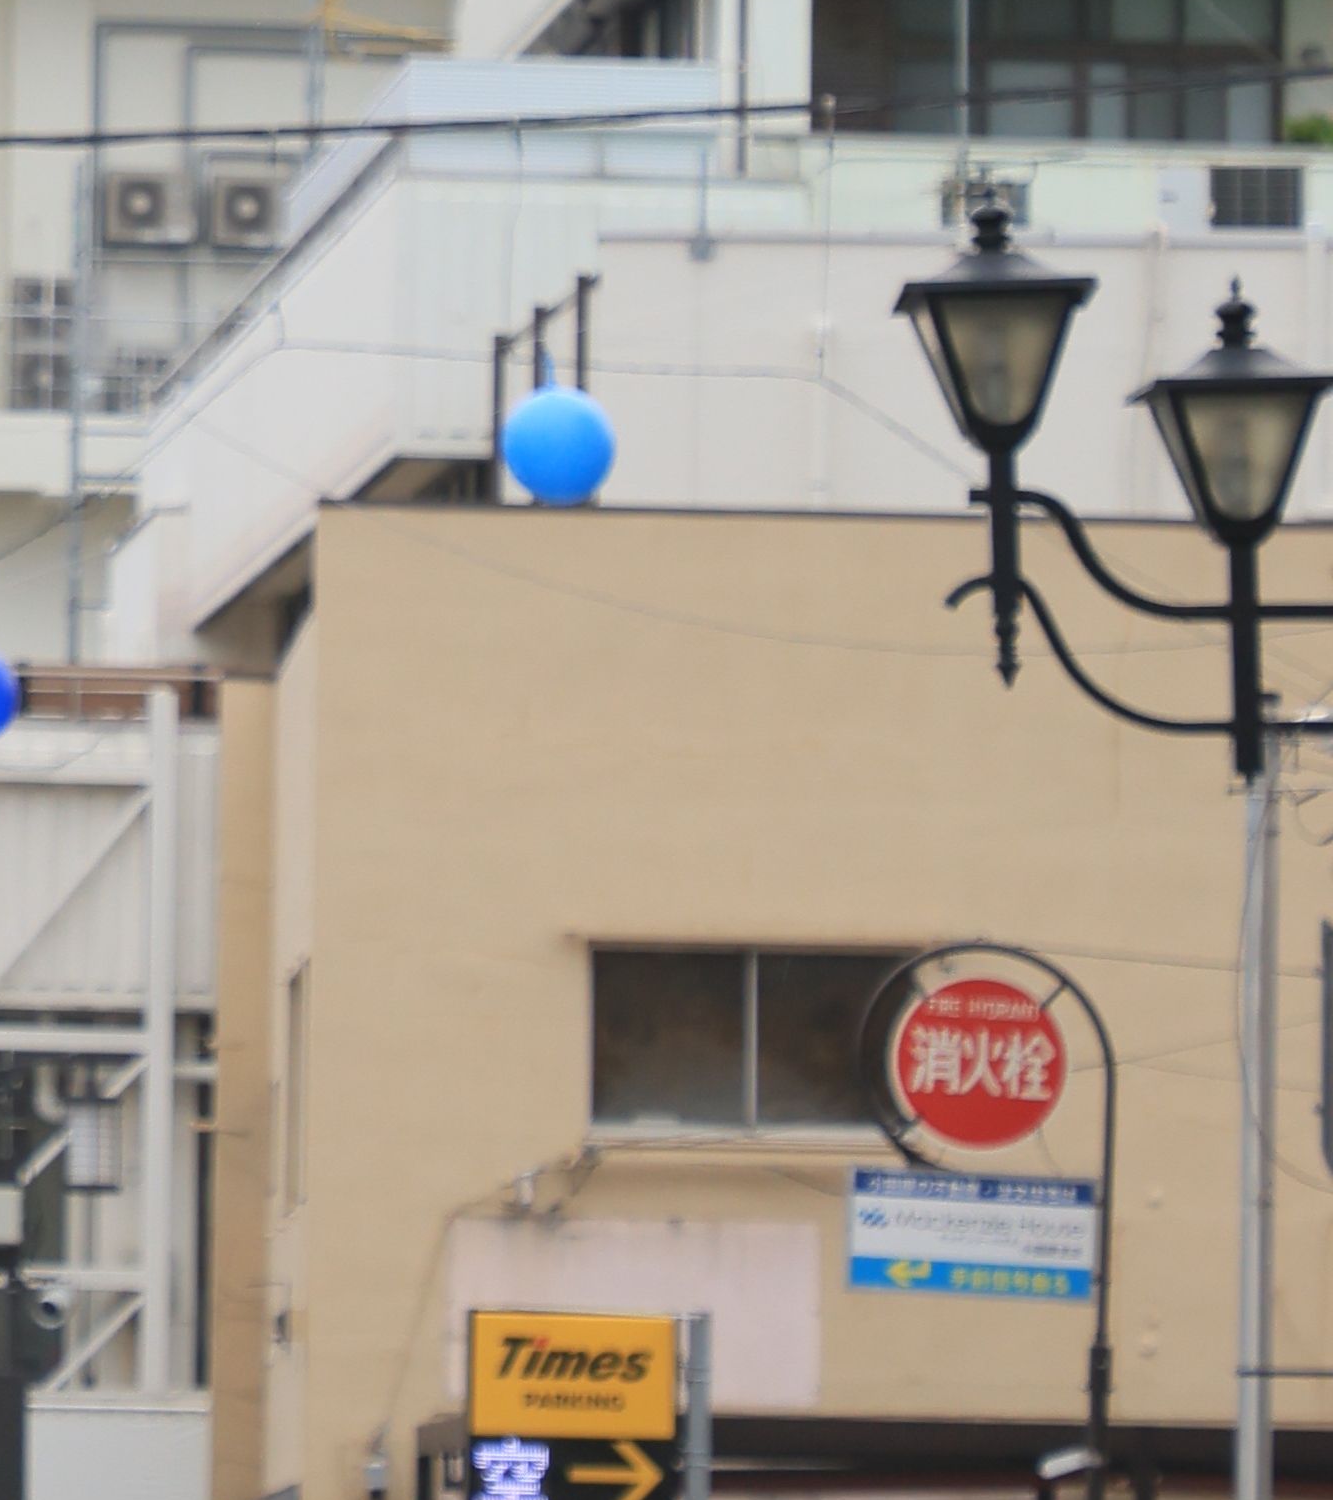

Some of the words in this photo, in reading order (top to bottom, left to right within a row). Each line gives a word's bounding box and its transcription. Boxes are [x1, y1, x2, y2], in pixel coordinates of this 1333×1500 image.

[909, 1026, 1057, 1101] 消火栓
[496, 1335, 651, 1383] Times
[523, 1392, 627, 1411] PARKING
